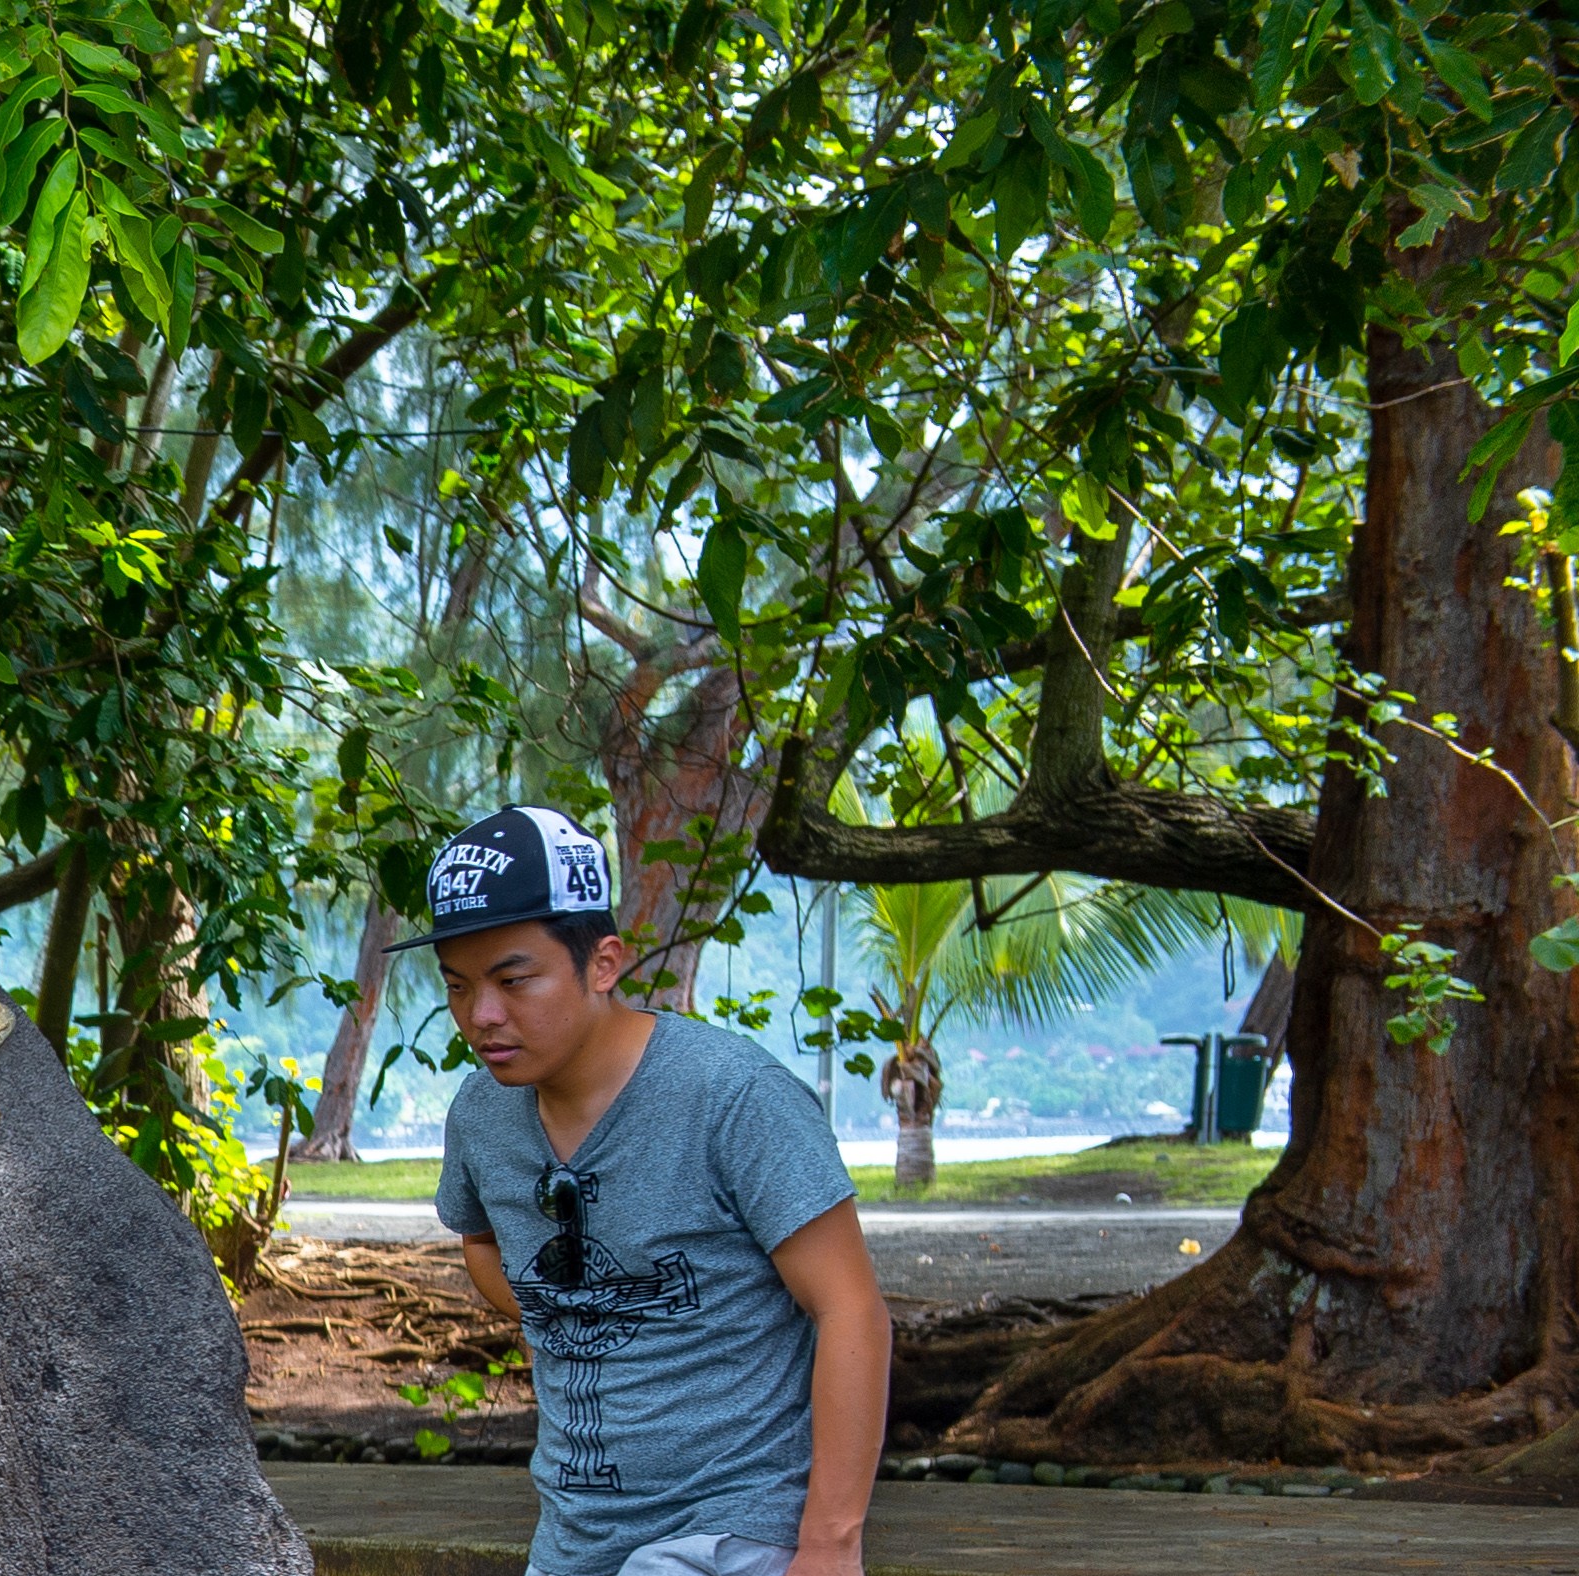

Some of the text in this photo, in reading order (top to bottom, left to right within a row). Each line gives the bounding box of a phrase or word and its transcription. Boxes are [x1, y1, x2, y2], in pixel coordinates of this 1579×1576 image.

[436, 869, 484, 900] 1947
[566, 864, 603, 902] 49
[453, 894, 488, 912] YORK
